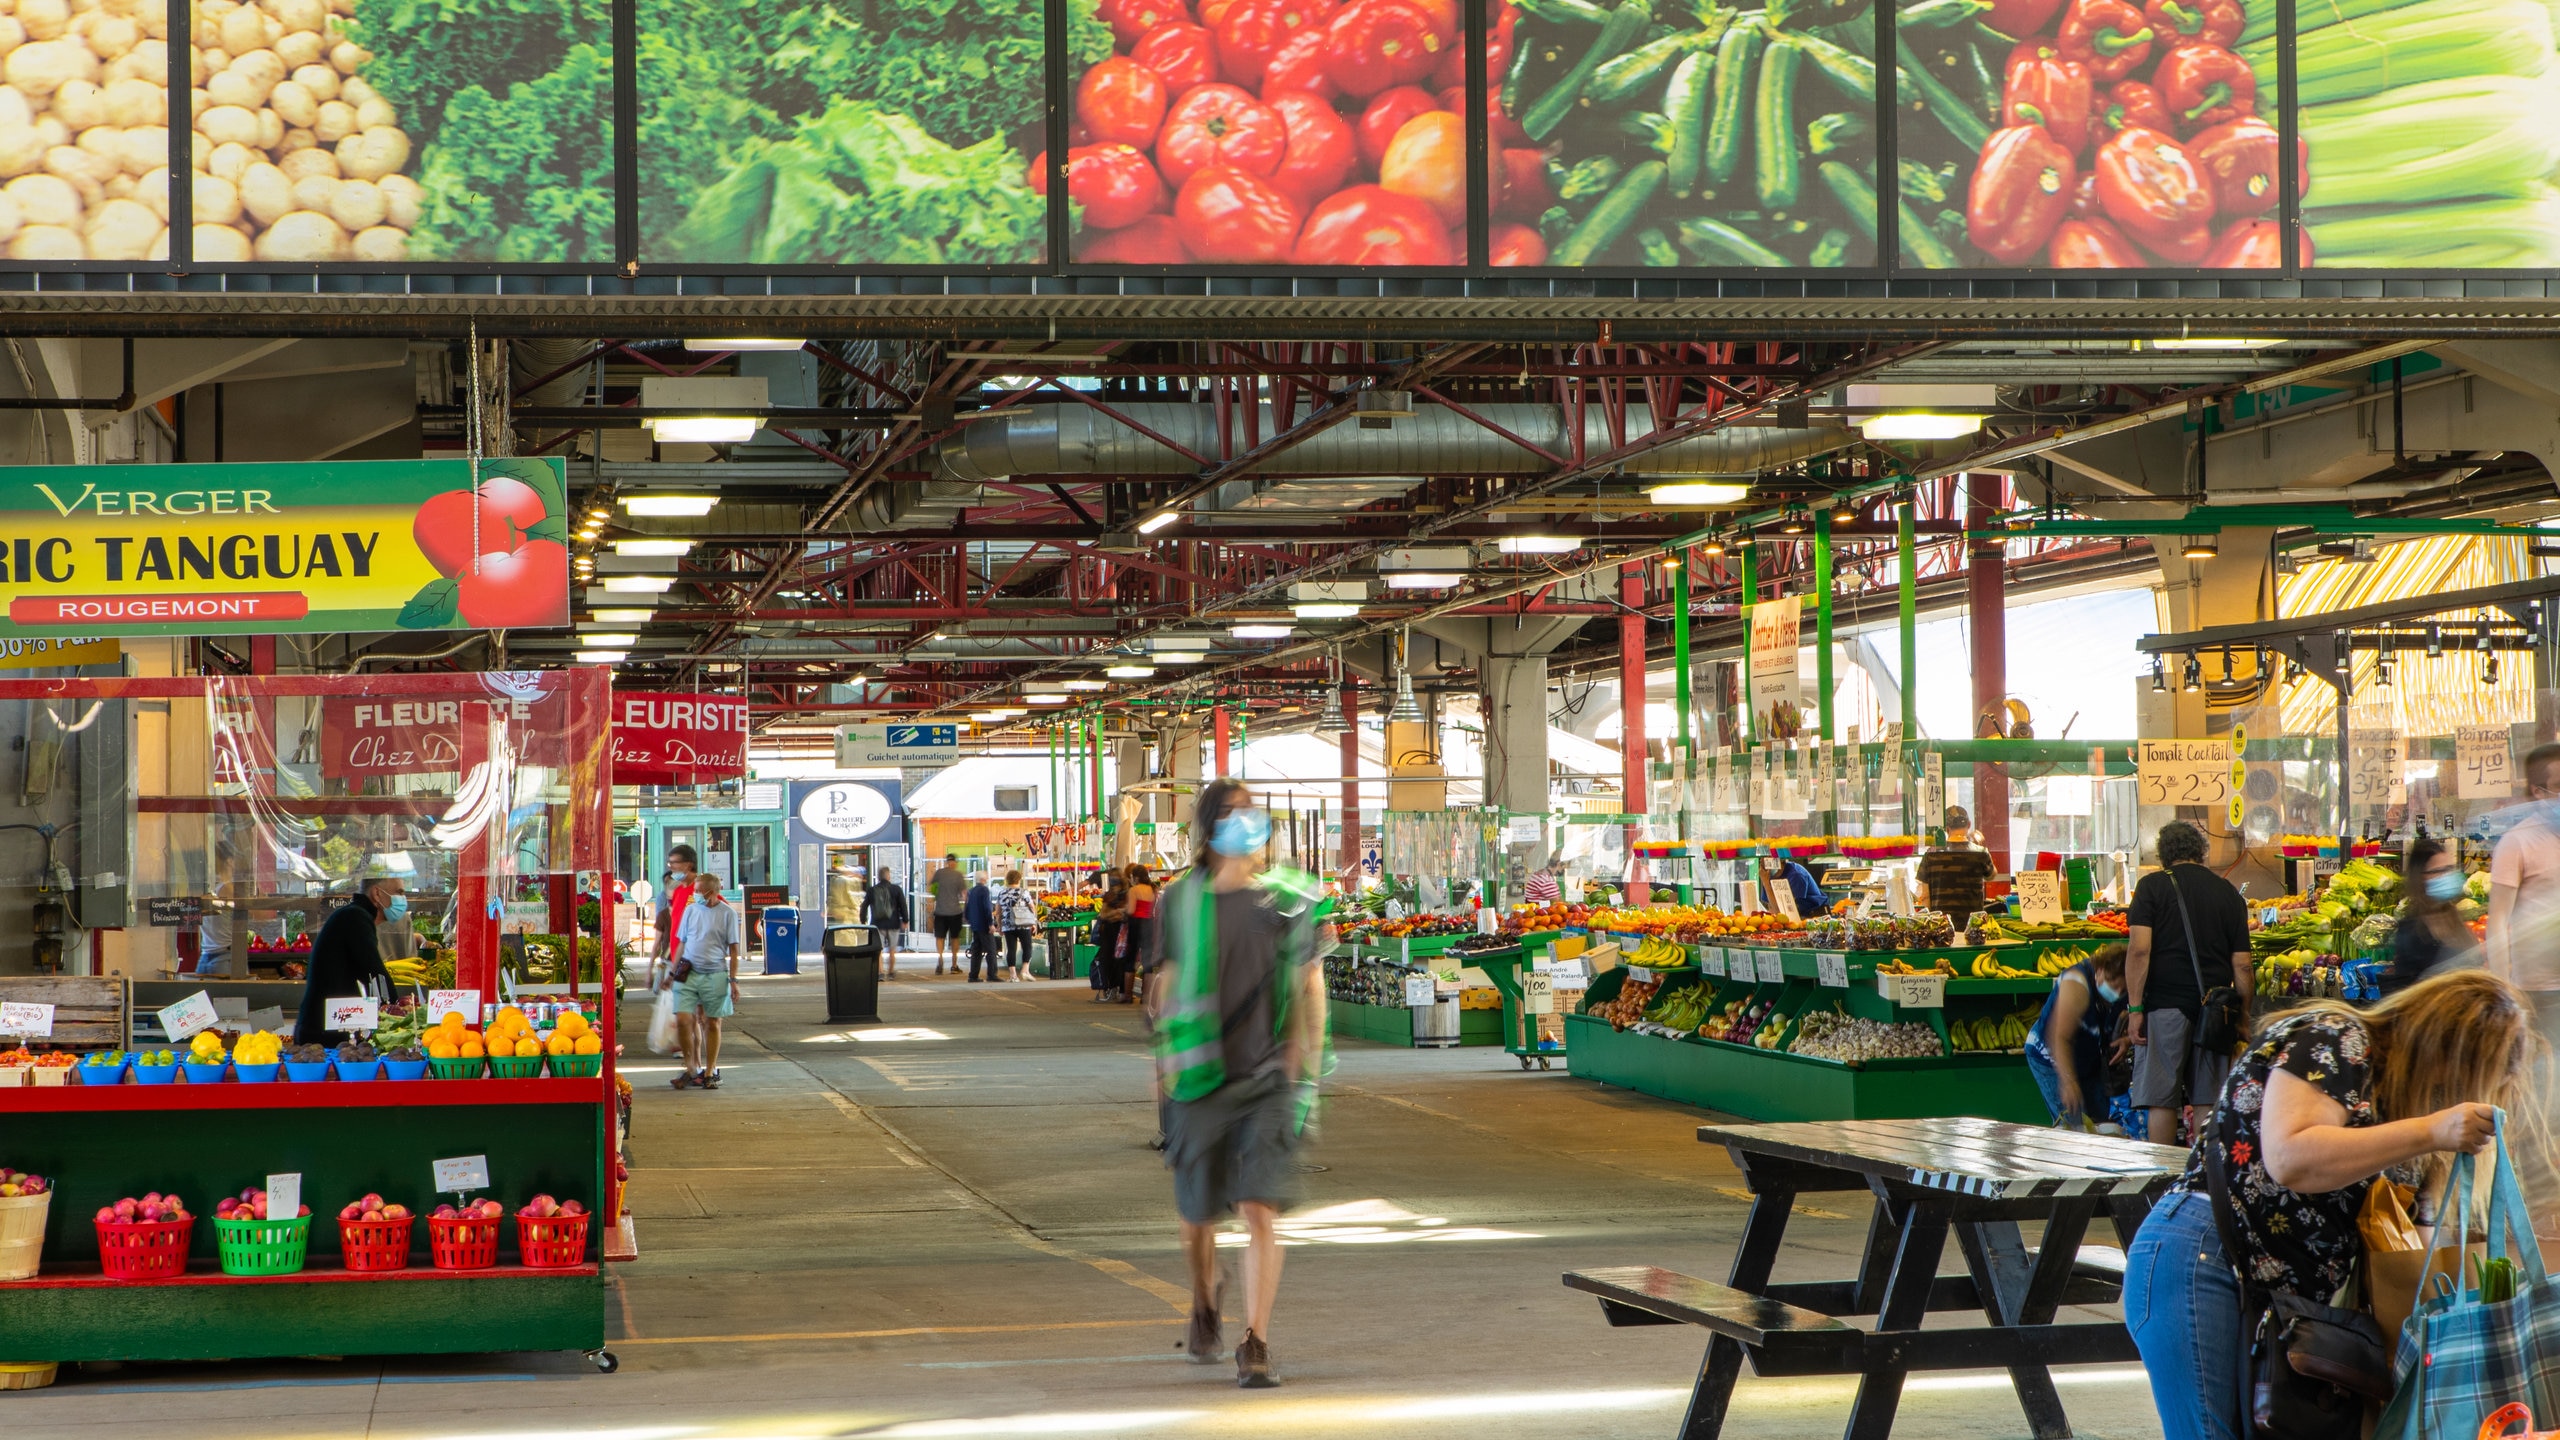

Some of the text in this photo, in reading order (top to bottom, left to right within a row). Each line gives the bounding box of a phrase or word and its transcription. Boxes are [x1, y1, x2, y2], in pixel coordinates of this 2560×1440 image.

[95, 532, 380, 581] TANGUAY
[58, 599, 260, 618] ROUGEMONT
[1754, 655, 1794, 669] FRUITS ET LÉGUMES
[350, 736, 415, 767] Chez
[611, 737, 746, 767] hez Daniel
[866, 752, 955, 762] Guichet automatique
[2143, 741, 2229, 762] Tomate Cocktail
[437, 991, 467, 1000] ORANGE
